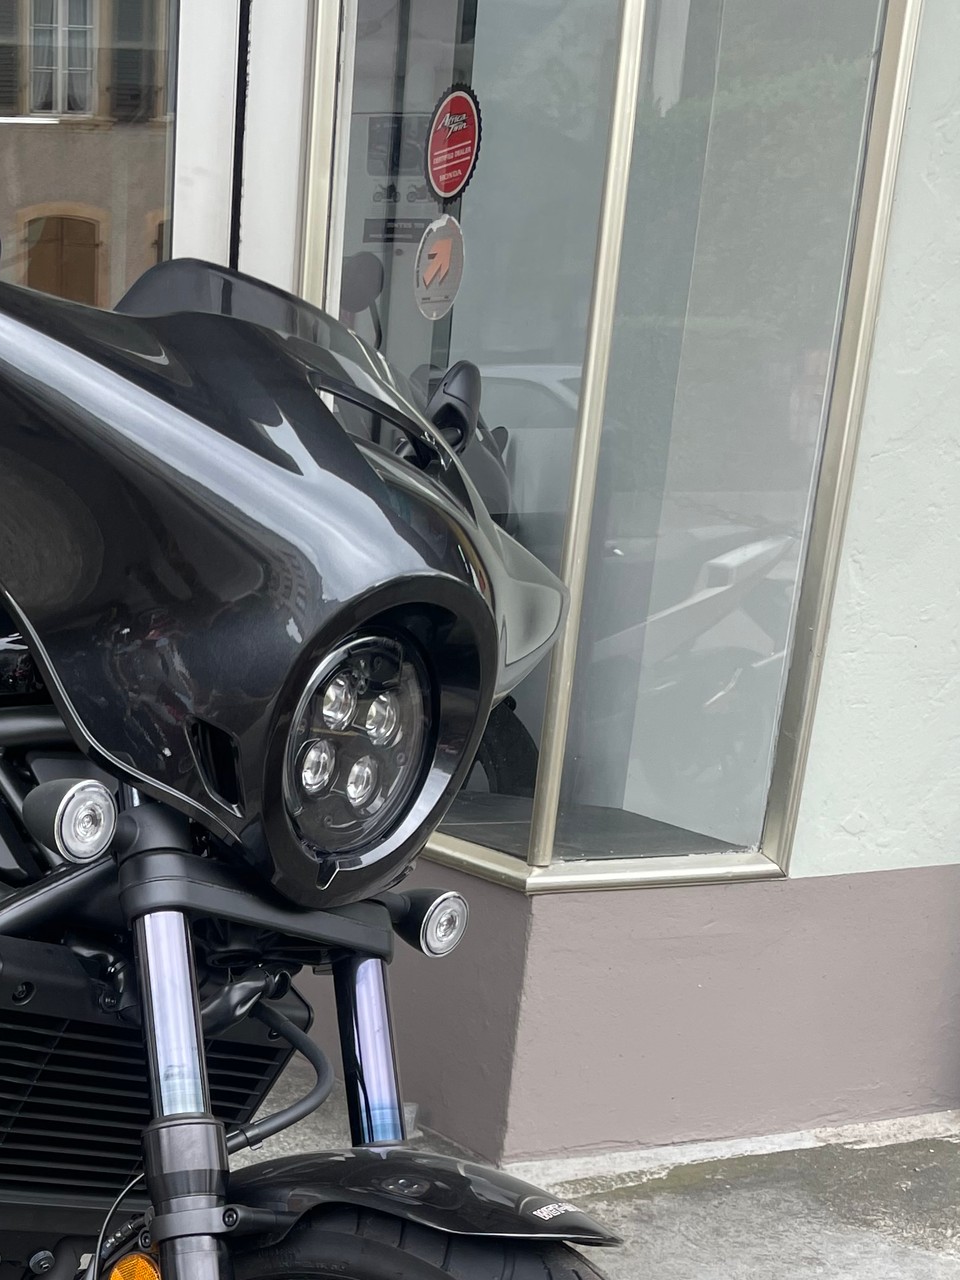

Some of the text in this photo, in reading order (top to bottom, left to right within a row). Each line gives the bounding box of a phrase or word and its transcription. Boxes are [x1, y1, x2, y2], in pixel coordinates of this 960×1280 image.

[437, 113, 468, 130] Africa
[446, 122, 467, 139] Twin
[439, 169, 462, 182] HONDA
